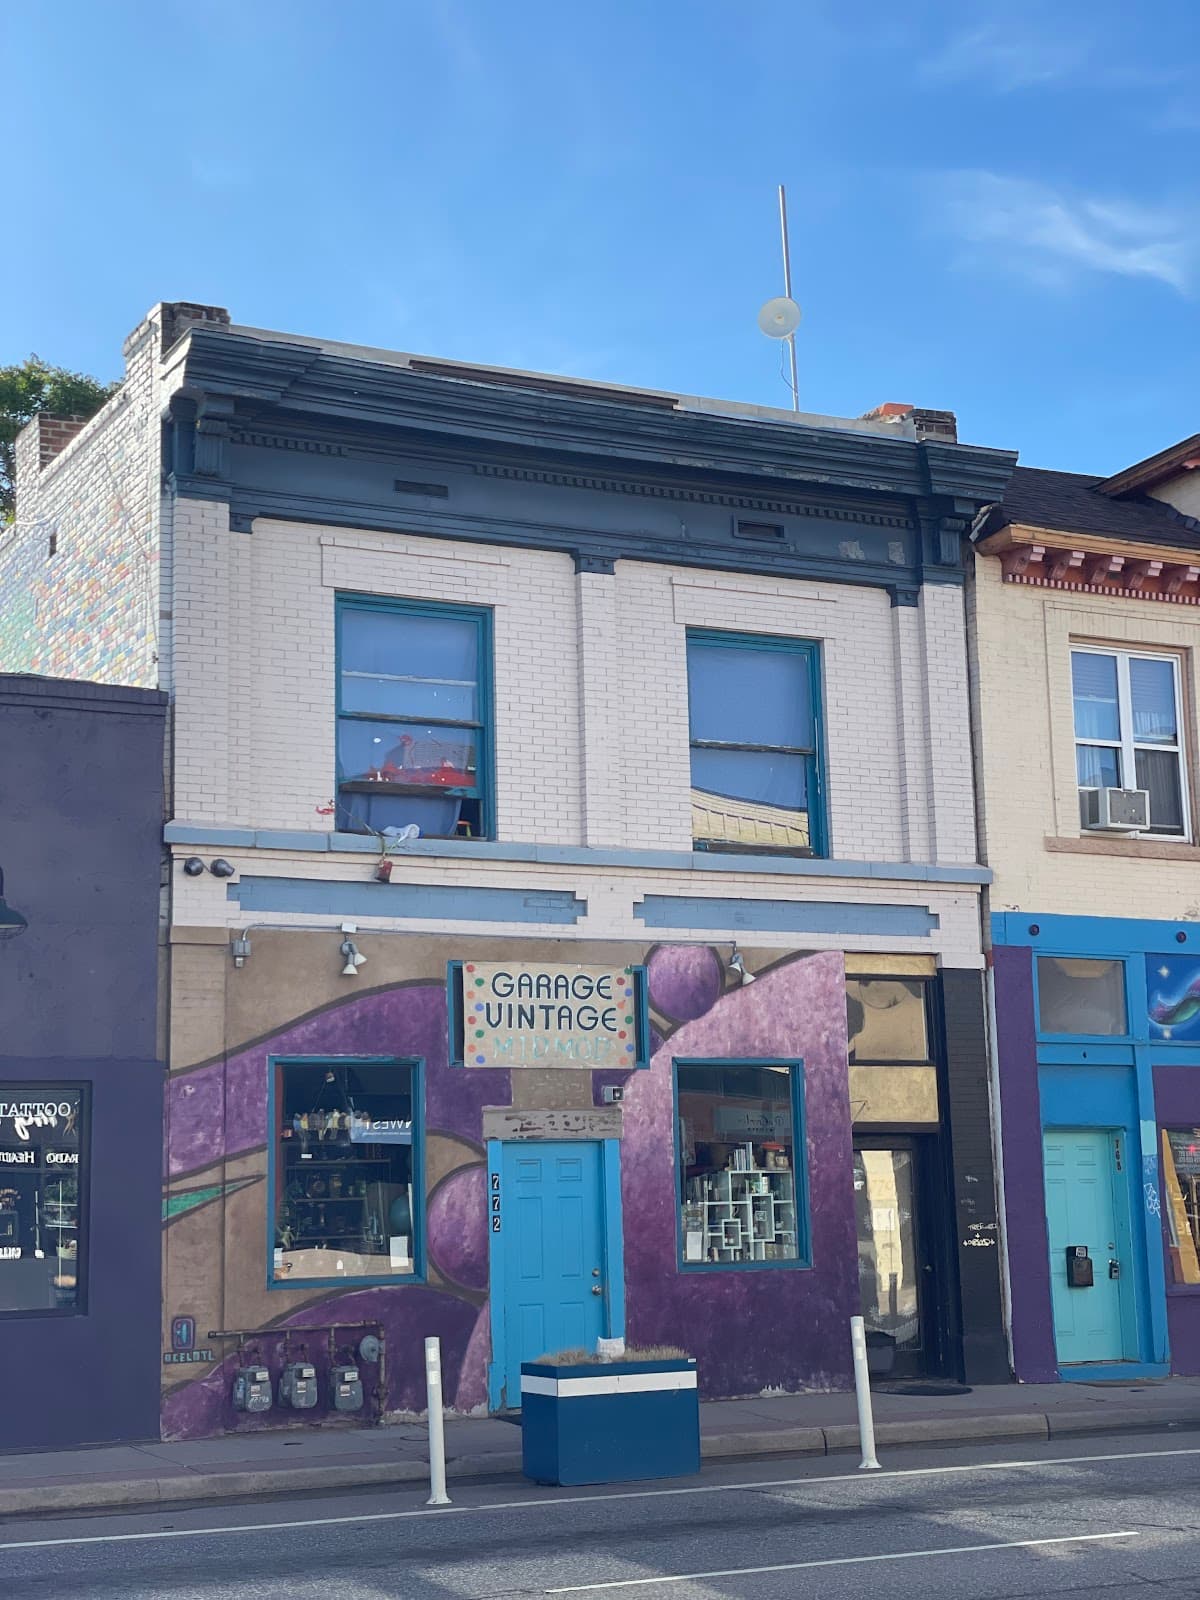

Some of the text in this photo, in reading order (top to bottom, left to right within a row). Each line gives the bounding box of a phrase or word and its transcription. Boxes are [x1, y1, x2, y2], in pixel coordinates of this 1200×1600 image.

[491, 972, 613, 1000] GARAGE
[485, 1002, 617, 1032] VINTAGE
[0, 1102, 71, 1117] TATTOO
[492, 1174, 500, 1231] 772
